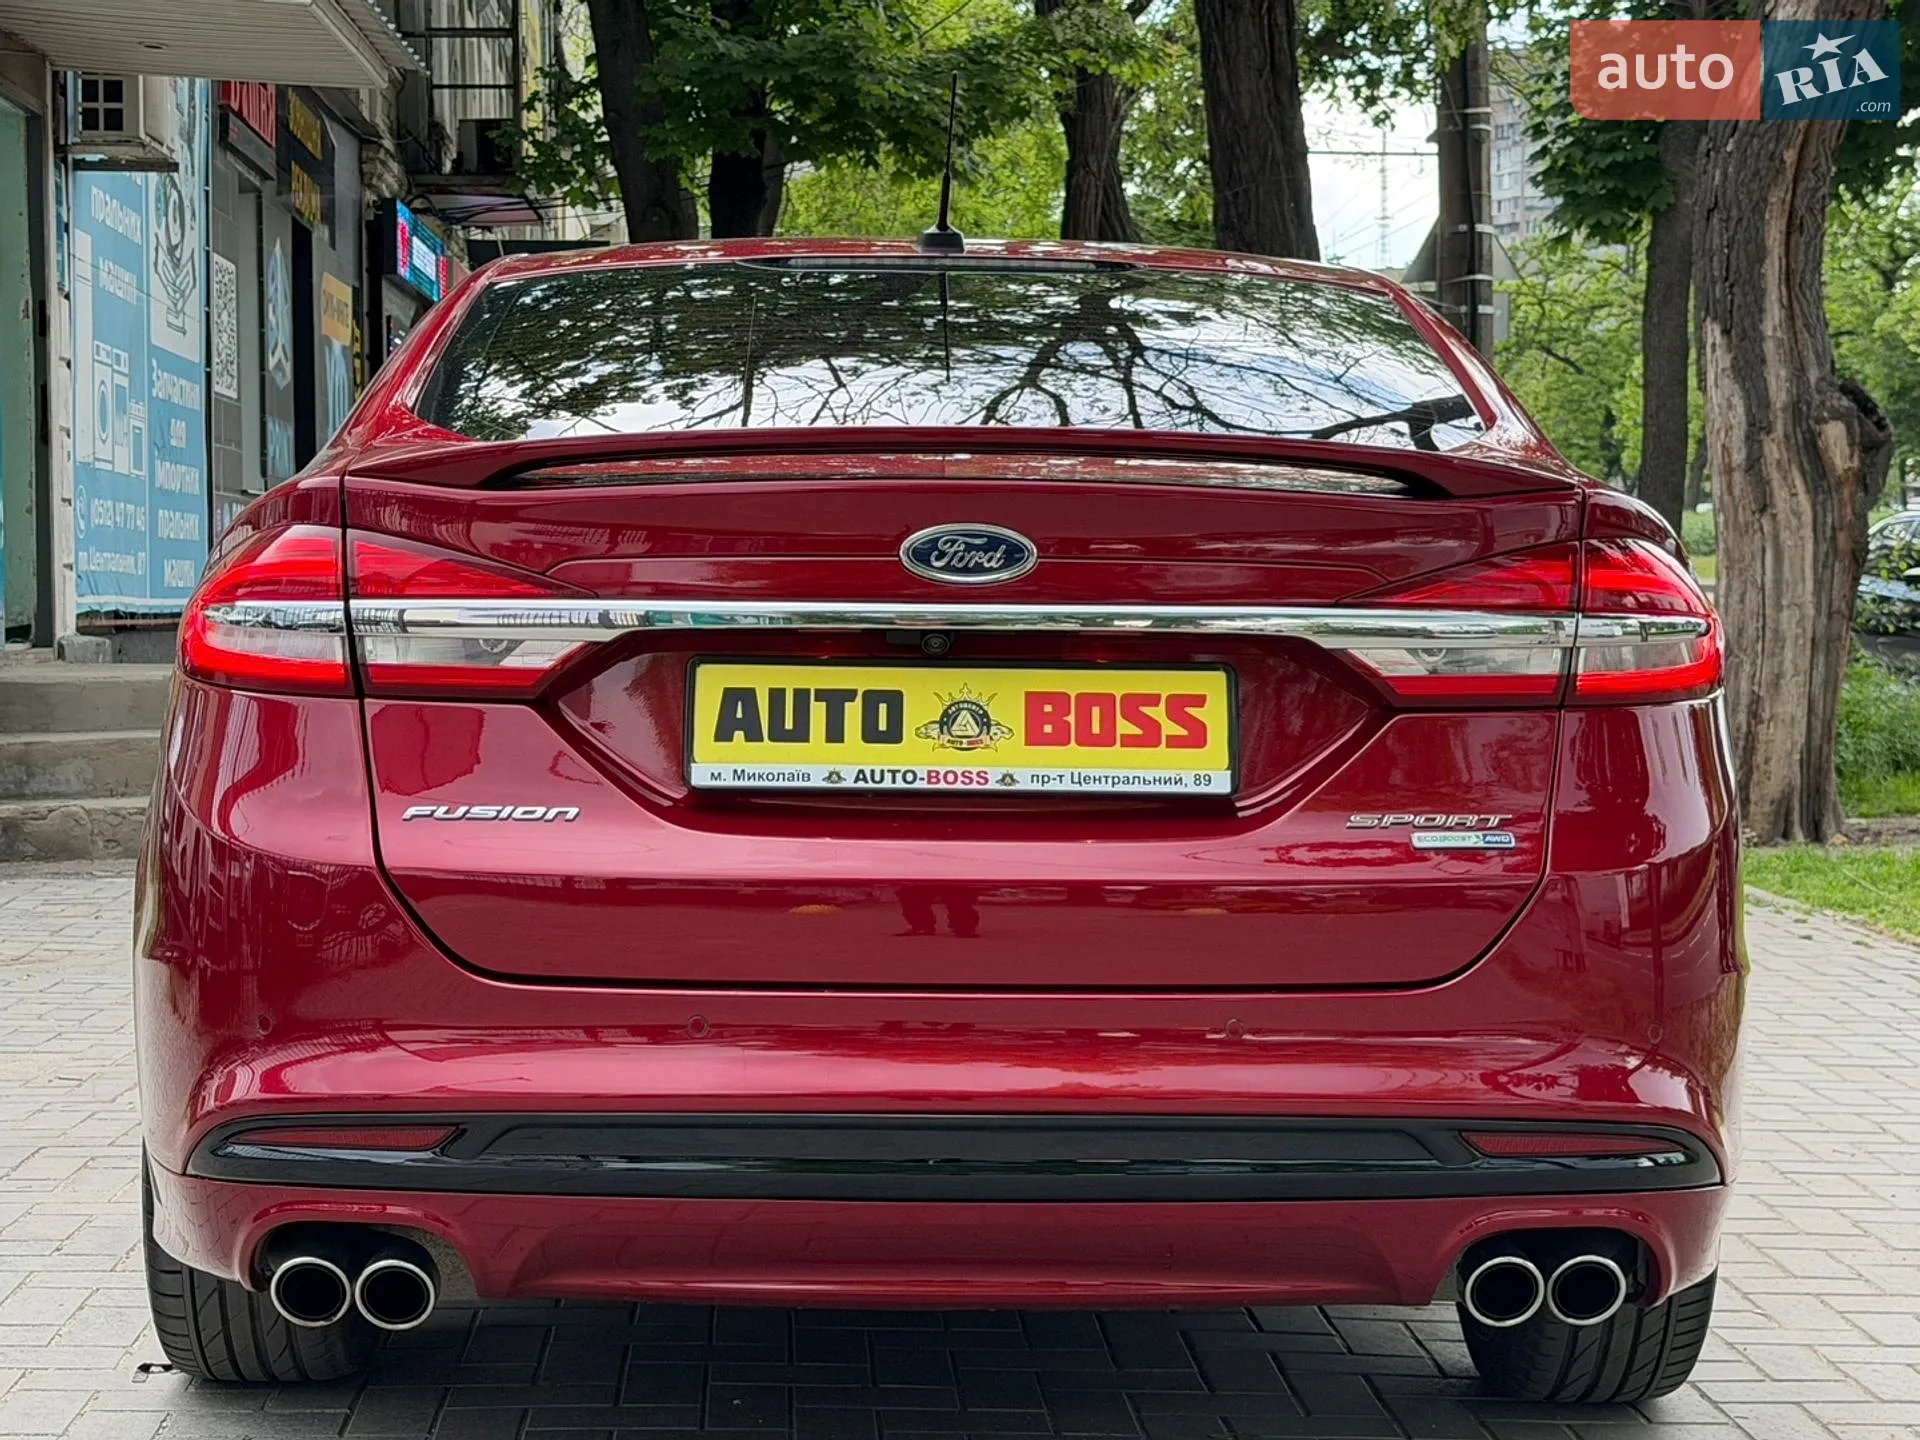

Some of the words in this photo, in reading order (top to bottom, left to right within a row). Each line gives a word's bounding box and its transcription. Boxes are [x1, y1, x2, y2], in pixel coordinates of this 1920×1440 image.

[929, 535, 1007, 568] Ford
[712, 687, 905, 745] AUTO
[1023, 690, 1208, 749] BOSS
[709, 771, 727, 782] м.
[732, 768, 811, 783] Миколаїв
[853, 768, 990, 786] AUTO-BOSS
[1030, 773, 1065, 787] пр-т
[1070, 772, 1188, 788] Центральний,
[1193, 773, 1212, 786] 89
[402, 805, 581, 822] FUSION
[1346, 813, 1512, 830] SPORT
[1483, 835, 1511, 843] AWD
